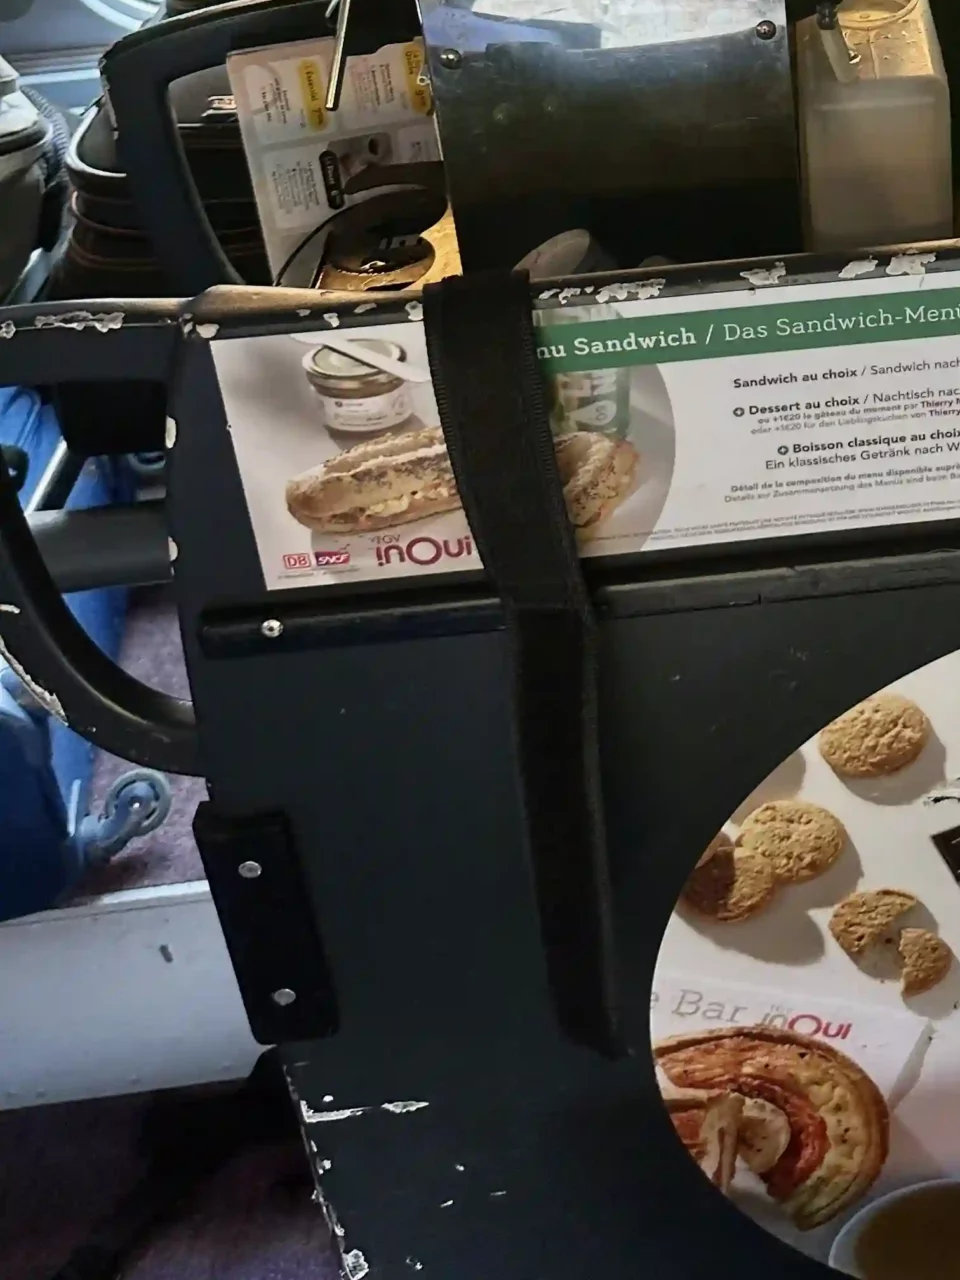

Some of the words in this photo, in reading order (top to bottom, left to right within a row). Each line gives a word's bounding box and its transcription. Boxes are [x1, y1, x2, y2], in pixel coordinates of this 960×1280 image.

[574, 327, 697, 357] Sandwich
[704, 324, 715, 345] /
[724, 322, 769, 342] Das
[733, 372, 798, 388] Sandwich
[802, 373, 818, 382] au
[822, 368, 858, 380] choix
[870, 360, 930, 375] Sandwich
[749, 401, 801, 415] Dessert
[805, 400, 821, 410] au
[824, 396, 860, 408] choix
[872, 388, 935, 404] Nachtisch
[848, 408, 861, 416] du
[904, 403, 919, 412] par
[920, 399, 954, 409] Thierry
[910, 411, 927, 419] von
[765, 459, 785, 470] Ein
[788, 452, 857, 468] klassisches
[860, 446, 911, 461] Getränk
[914, 443, 943, 456] nach
[792, 441, 844, 454] Boisson
[847, 434, 907, 448] classique
[910, 433, 926, 442] au
[731, 483, 758, 493] Détail
[843, 473, 856, 481] du
[858, 471, 883, 480] menu
[886, 466, 932, 478] disponible
[285, 555, 309, 568] DB
[317, 553, 349, 565] SNCF
[672, 988, 748, 1024] Bar
